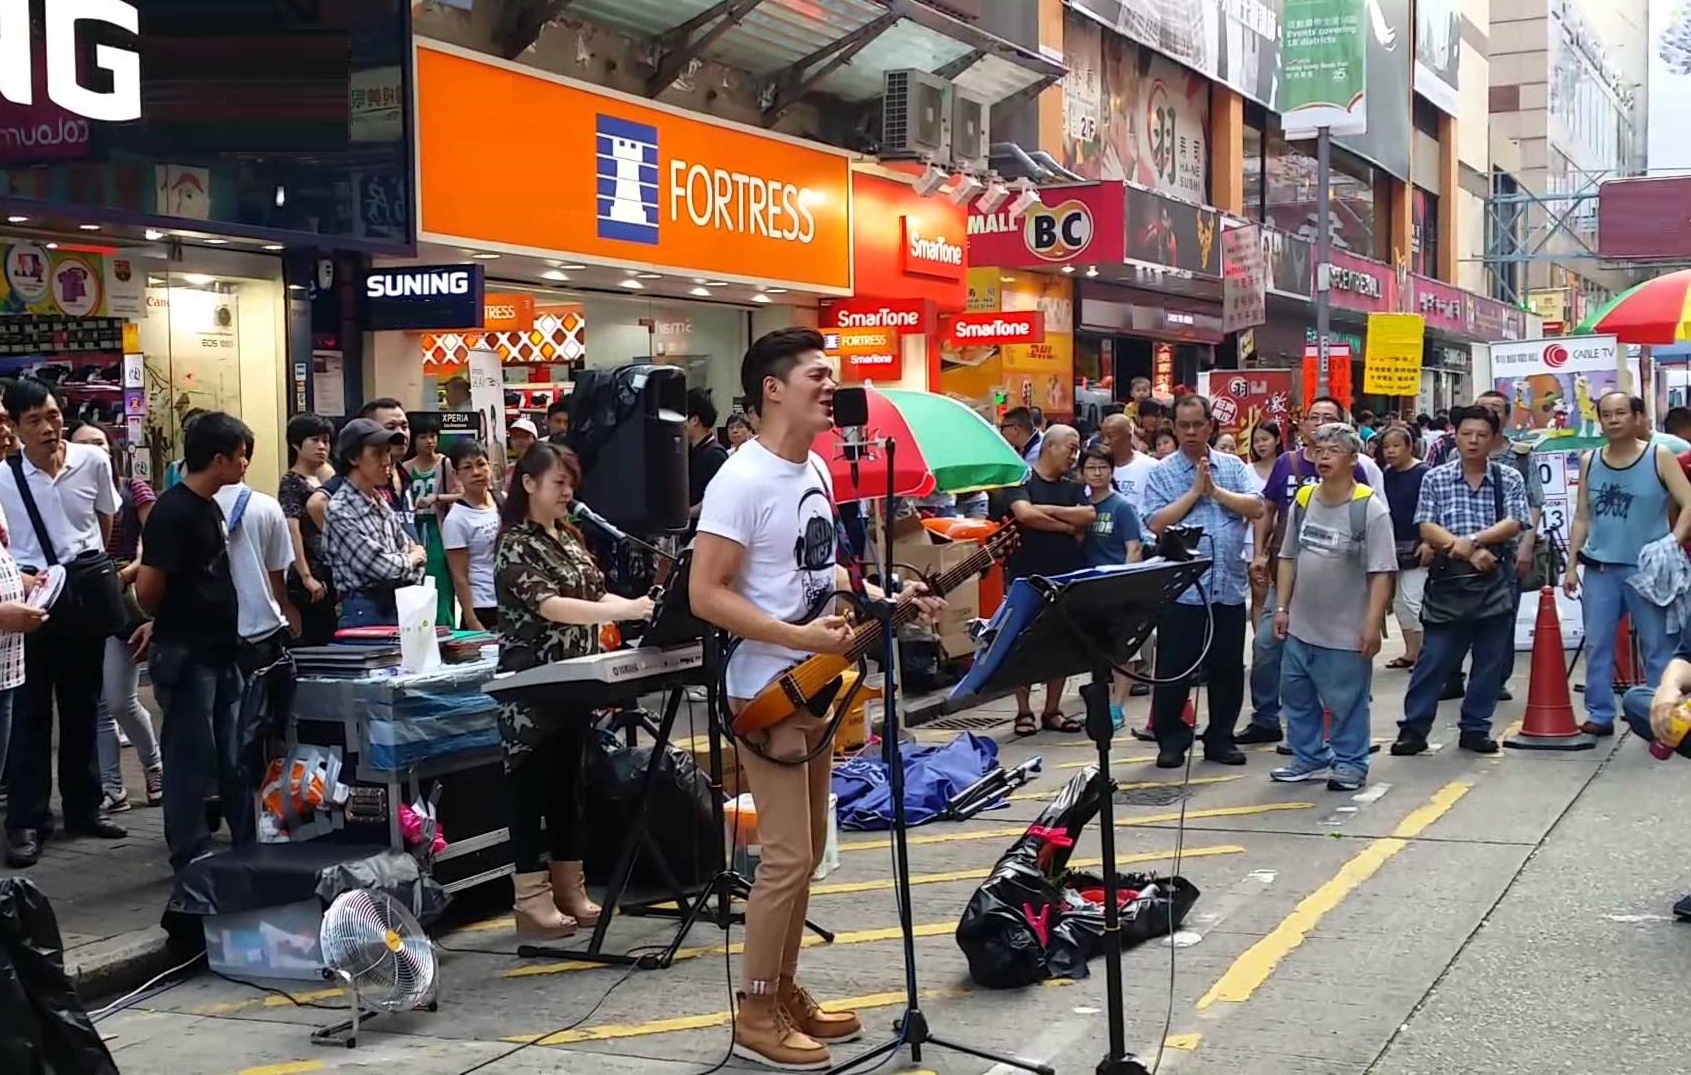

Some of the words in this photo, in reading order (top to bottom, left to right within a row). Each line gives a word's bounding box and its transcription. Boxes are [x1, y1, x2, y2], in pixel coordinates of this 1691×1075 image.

[1319, 26, 1357, 36] covering
[1300, 36, 1337, 46] districts
[670, 158, 815, 243] FORTRESS
[968, 212, 1018, 234] MALL
[1034, 211, 1082, 249] BC
[910, 231, 962, 265] SmarTone
[366, 271, 469, 297] SUNING
[837, 308, 919, 328] SmarTone
[955, 320, 1030, 338] SmarTone
[202, 338, 218, 347] EOS
[841, 335, 887, 347] FORTRESS
[850, 354, 893, 364] SmarTone
[1573, 346, 1600, 359] CABLE
[1601, 347, 1615, 357] TV
[442, 413, 469, 423] XPERIA
